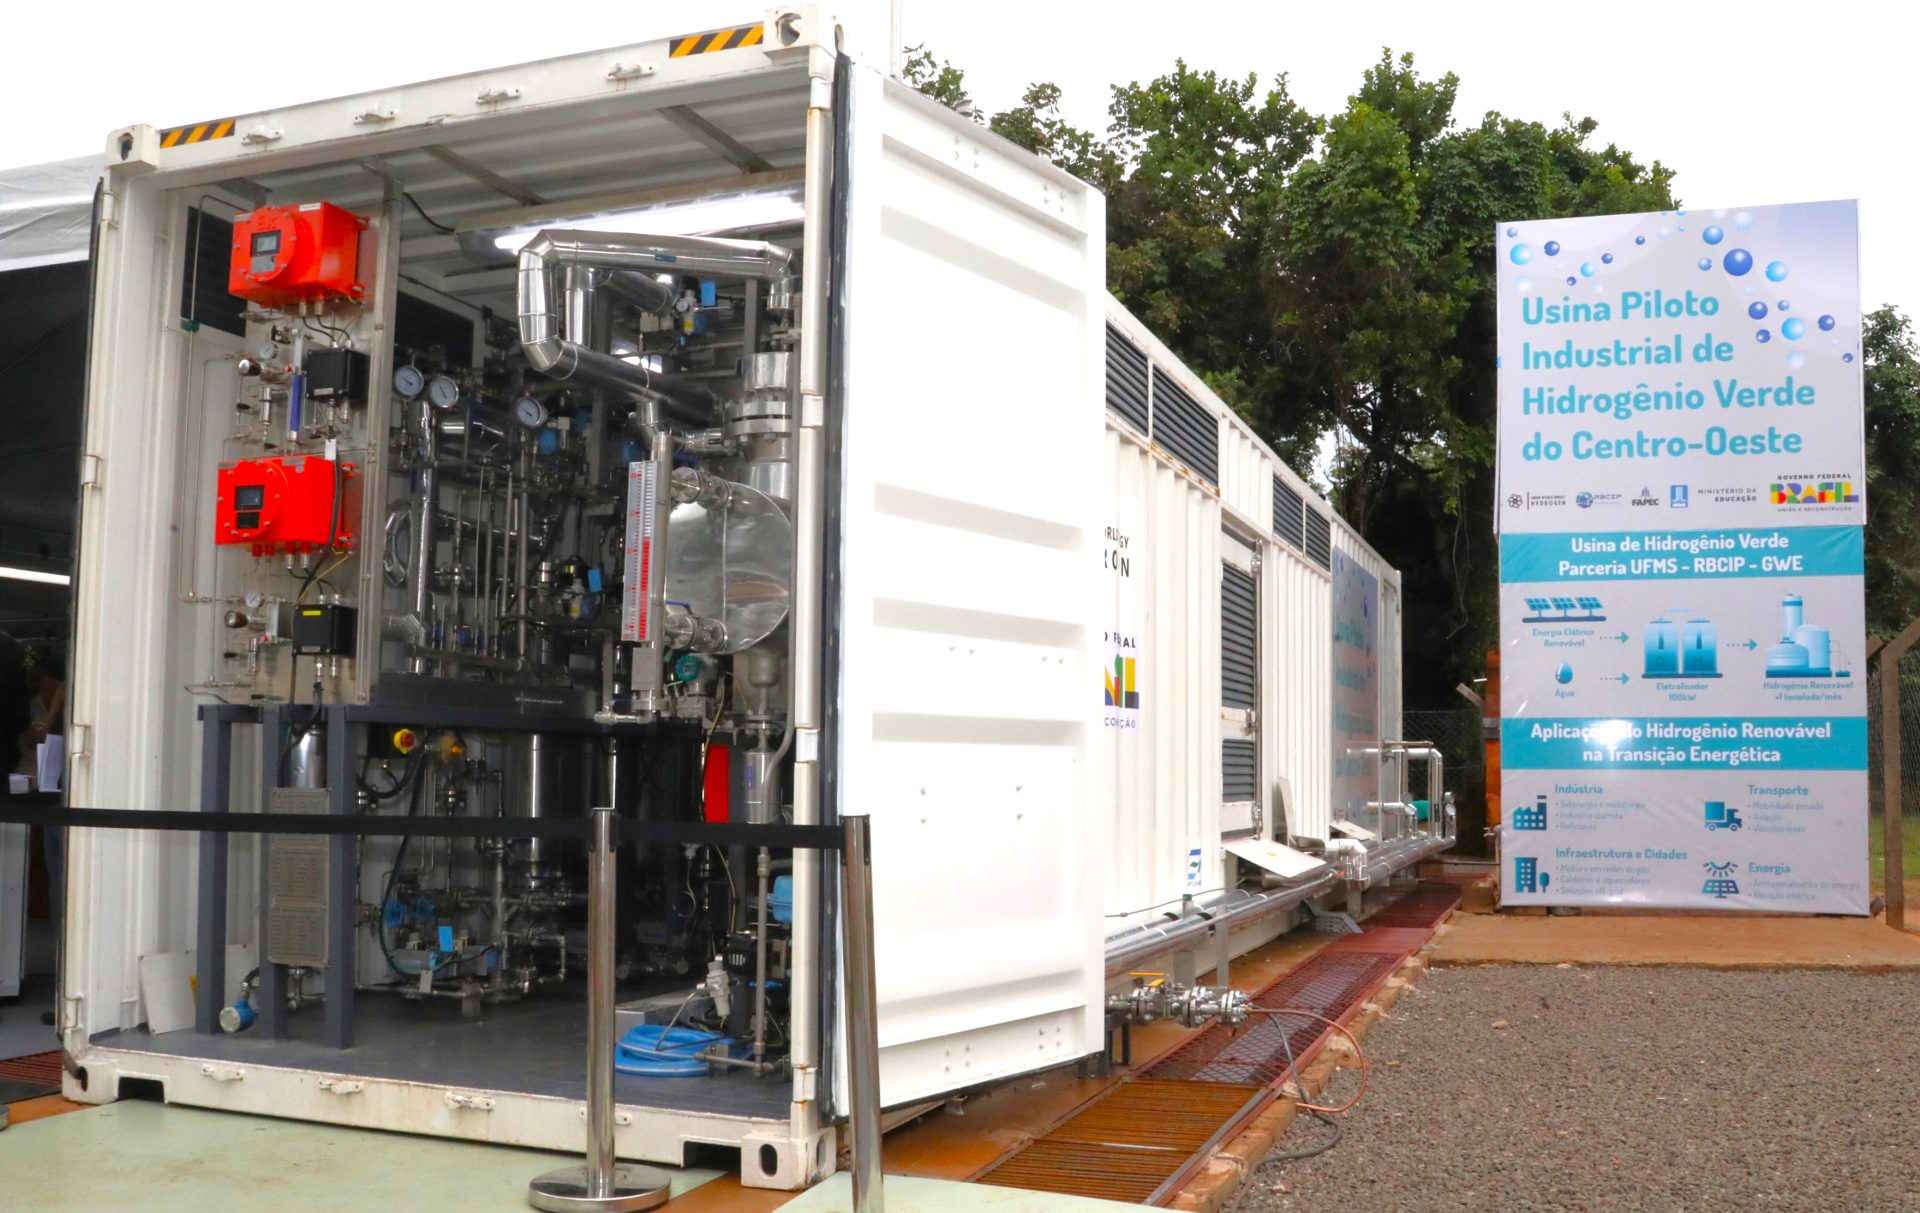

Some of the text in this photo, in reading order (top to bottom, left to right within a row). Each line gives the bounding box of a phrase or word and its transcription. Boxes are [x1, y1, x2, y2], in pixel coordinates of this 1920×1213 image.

[1522, 290, 1720, 325] Usina Piloto
[1522, 333, 1734, 370] Industrial de
[1522, 376, 1815, 420] Hidrogênio Verde
[1522, 426, 1802, 461] do Centro-Oeste
[1632, 498, 1659, 506] FAPEC
[1714, 495, 1757, 503] EDUCAÇÃO
[1769, 480, 1859, 505] BRASIL
[1571, 533, 1789, 554] Usina de Hidrogênio Verde
[1559, 560, 1627, 577] Parceria
[1631, 557, 1677, 573] UFMS
[1694, 556, 1745, 572] RBCIP
[1762, 555, 1803, 571] GWE
[1646, 722, 1738, 744] Hidrogênio
[1742, 722, 1831, 738] Renovável
[1583, 746, 1781, 766] na Transição Energética
[1554, 783, 1603, 794] Indústria
[1748, 784, 1809, 798] Transporte
[1555, 847, 1688, 860] Infraestrutura e Cidades
[1748, 862, 1791, 876] Energia
